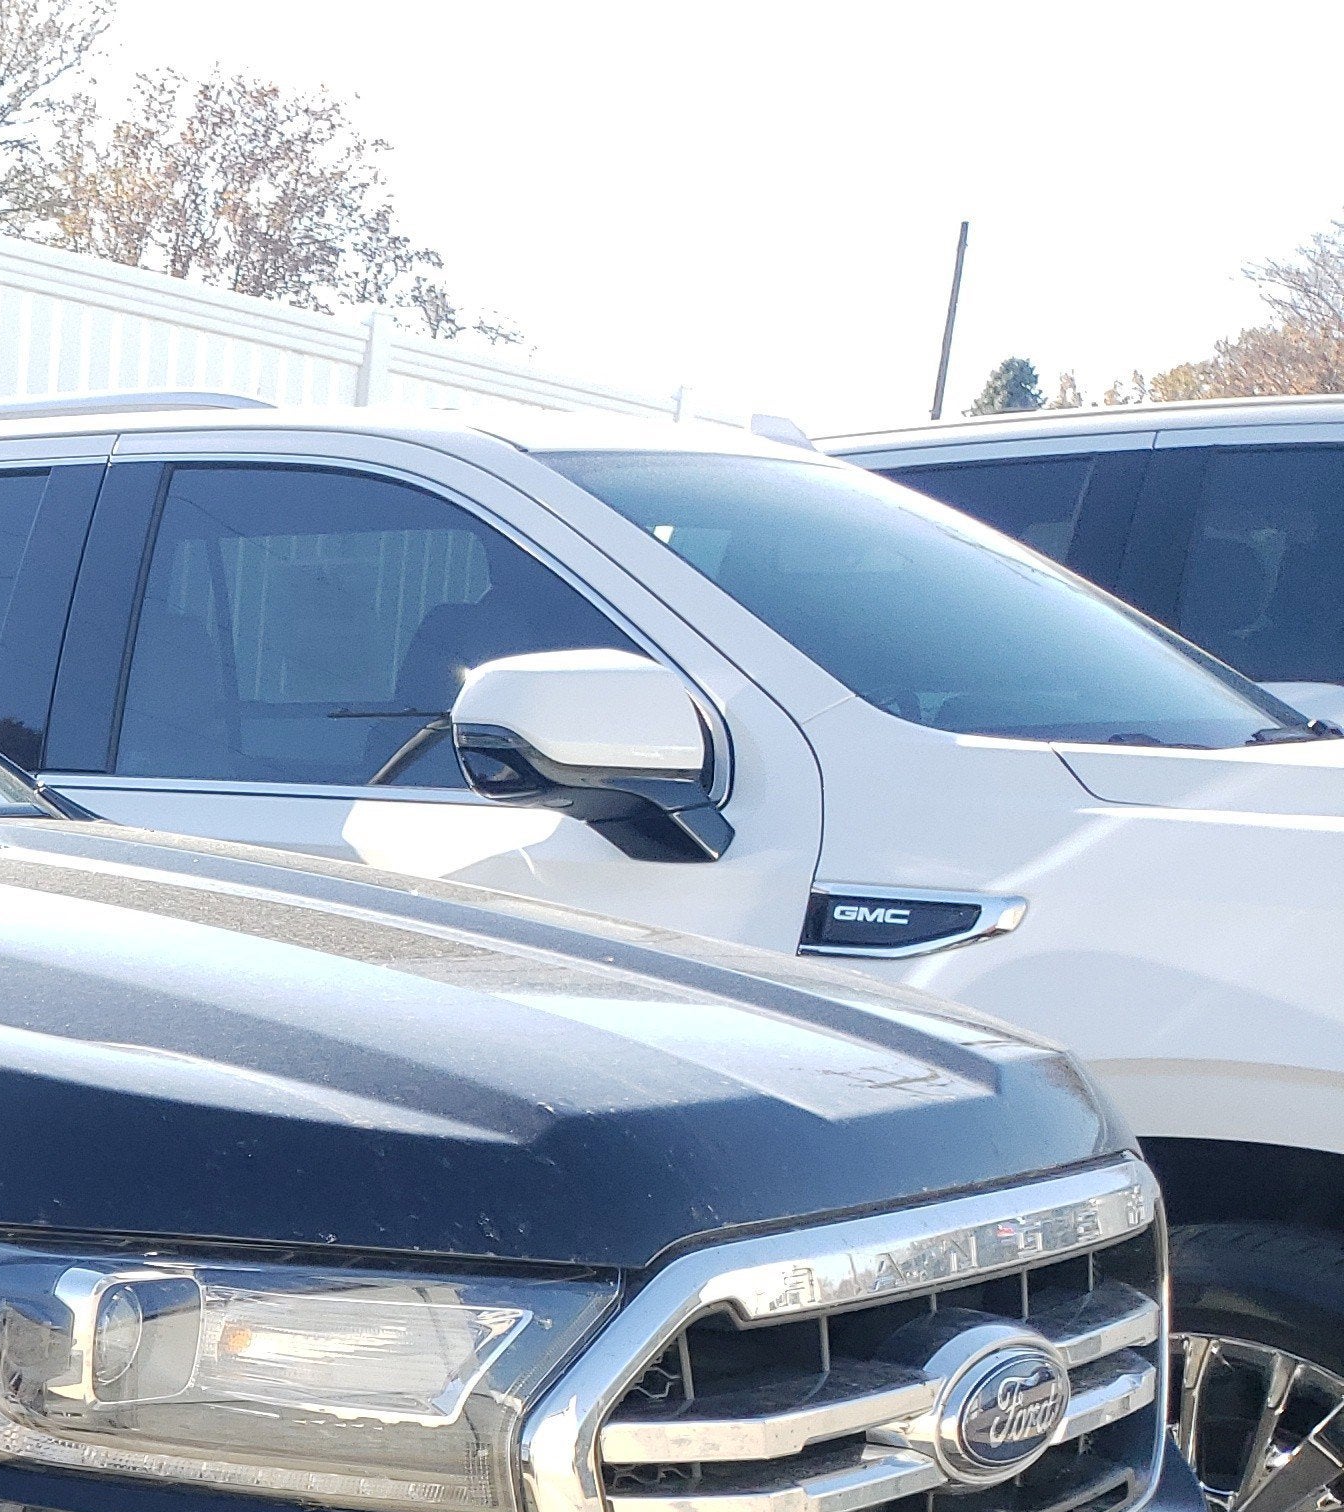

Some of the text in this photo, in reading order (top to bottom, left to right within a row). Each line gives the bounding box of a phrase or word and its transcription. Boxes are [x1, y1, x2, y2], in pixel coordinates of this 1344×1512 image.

[832, 904, 910, 925] GMC
[766, 1186, 1146, 1312] RANGER
[989, 1363, 1060, 1448] Ford
